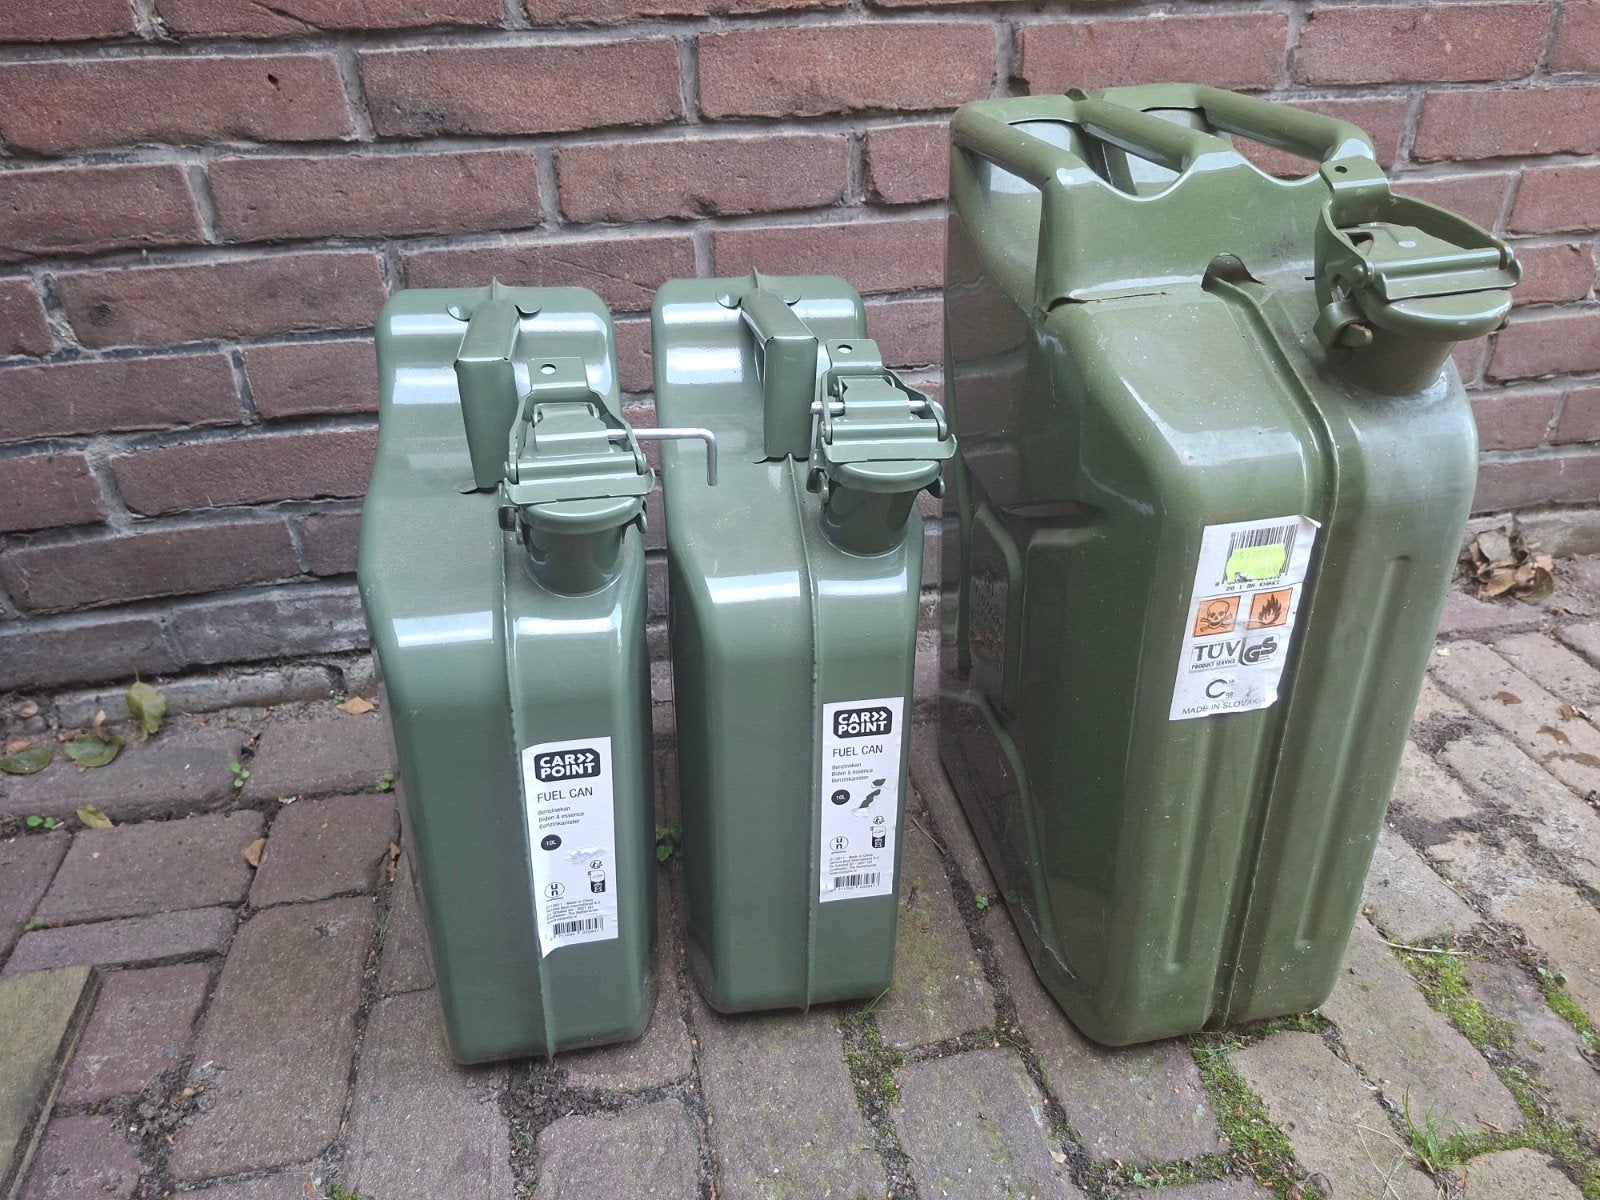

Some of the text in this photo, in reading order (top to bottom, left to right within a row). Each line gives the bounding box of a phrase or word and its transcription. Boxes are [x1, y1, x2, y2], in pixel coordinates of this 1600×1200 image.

[1194, 640, 1241, 662] TÜV
[1243, 636, 1278, 663] GS
[1215, 659, 1236, 667] SERVICE
[1182, 697, 1266, 715] MADE IN SLOVAKIA
[838, 711, 871, 725] CAR
[838, 720, 887, 735] POINT
[832, 744, 883, 758] FUEL CAN
[540, 754, 576, 768] CAR
[540, 762, 595, 779] POINT
[537, 787, 593, 803] FUEL CAN
